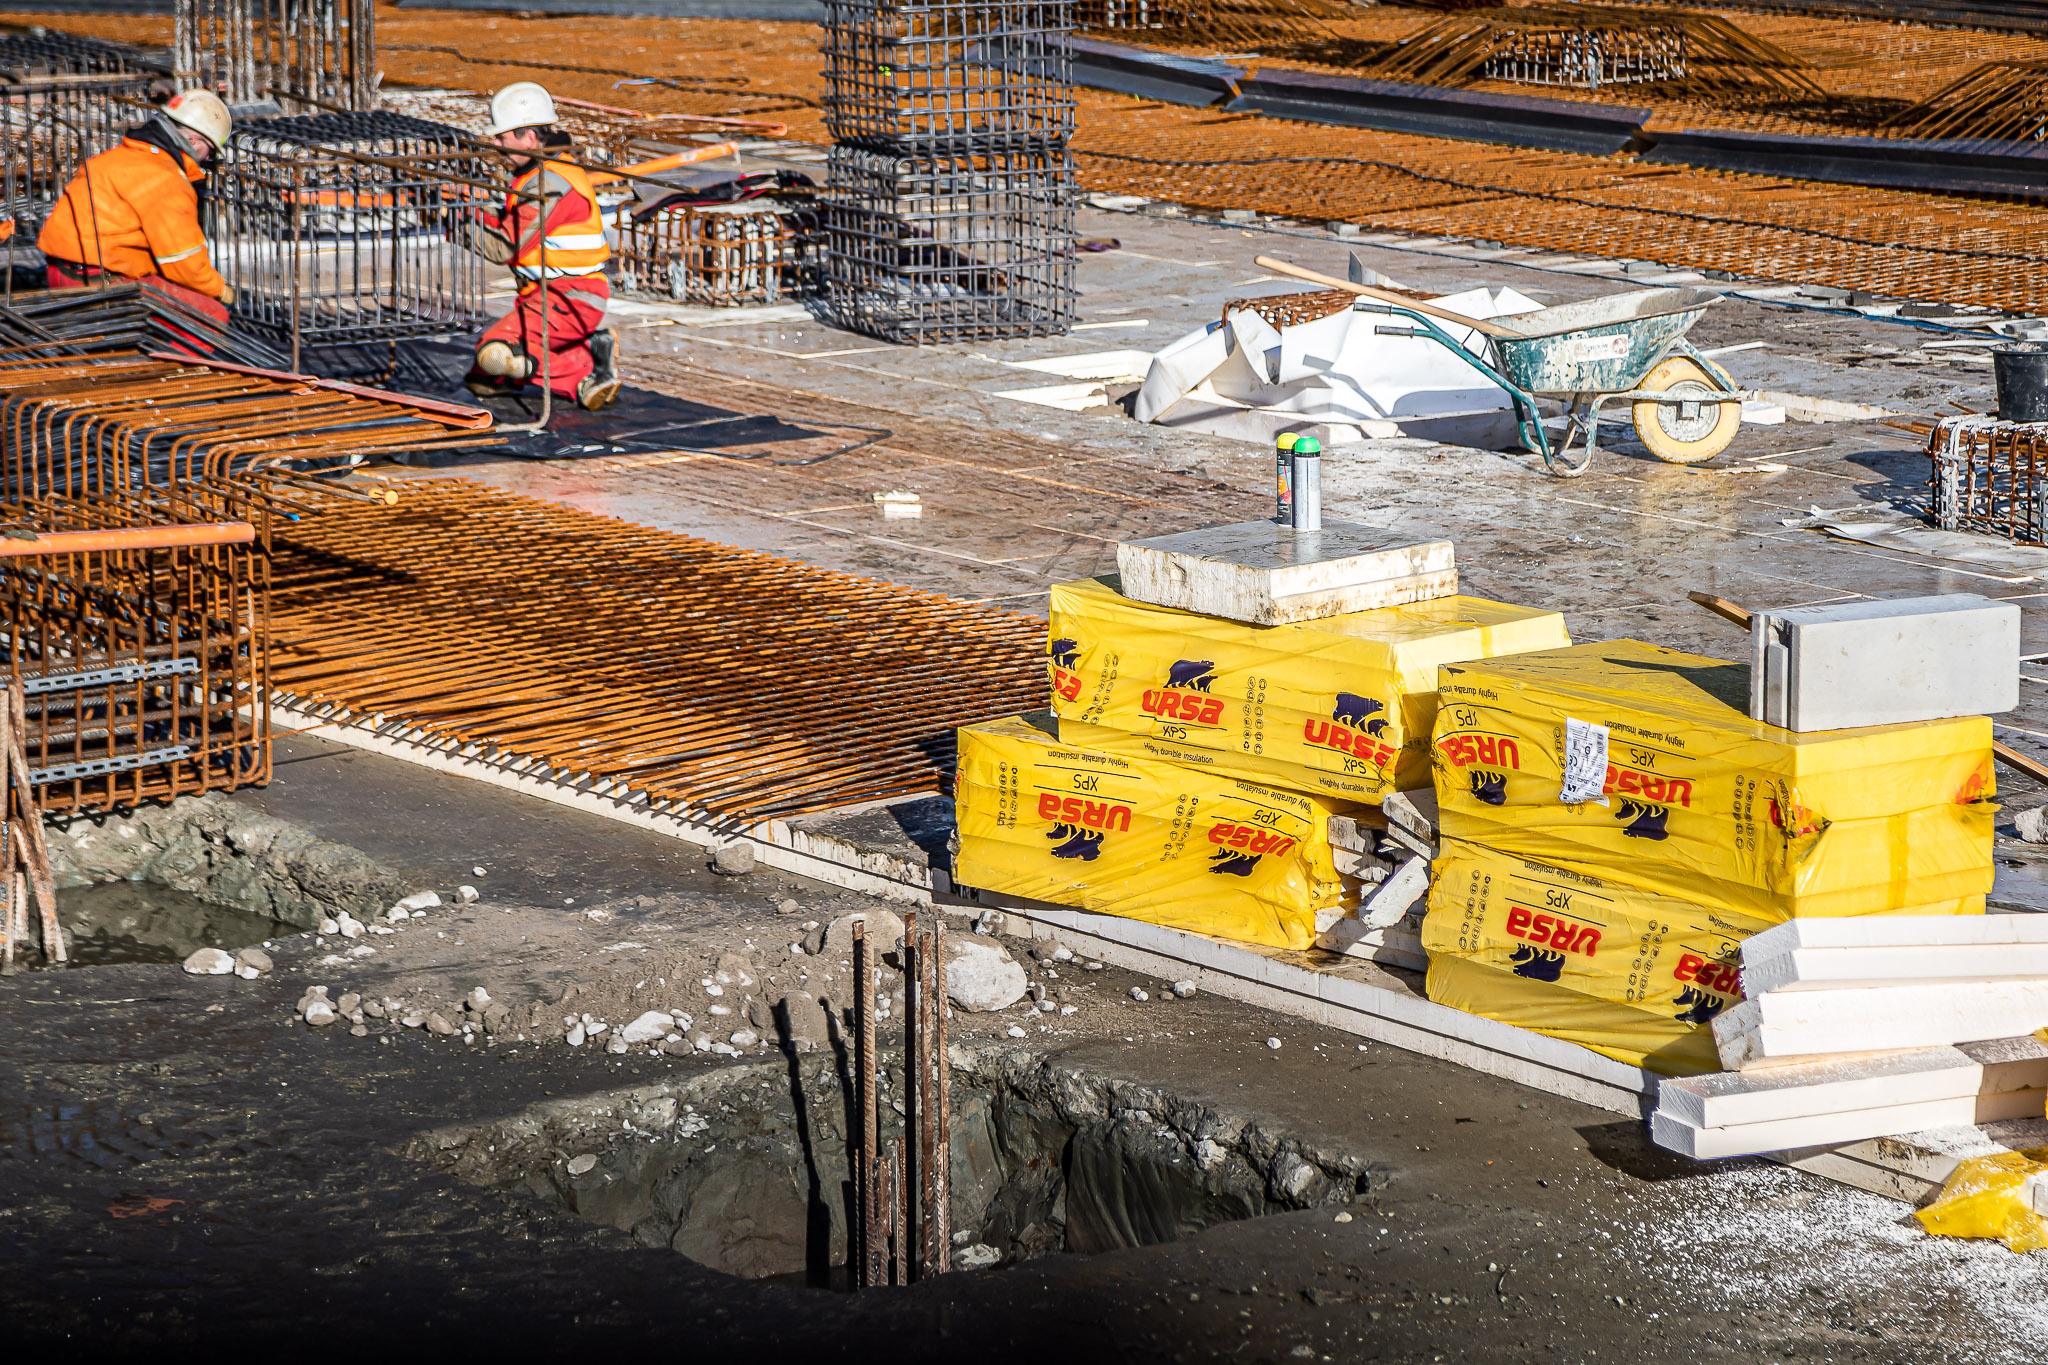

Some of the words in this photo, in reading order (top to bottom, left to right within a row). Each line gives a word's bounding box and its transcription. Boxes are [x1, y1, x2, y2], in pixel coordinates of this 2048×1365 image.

[1456, 709, 1480, 726] XPS
[1163, 726, 1187, 740] XPS
[1605, 720, 1637, 736] insulation
[1638, 729, 1664, 742] durable
[1665, 734, 1686, 749] Highly
[1047, 750, 1080, 760] insulation
[1081, 753, 1107, 764] durable
[1184, 752, 1214, 764] insulation
[1631, 749, 1656, 768] XPS
[1107, 757, 1129, 769] Highly
[1343, 757, 1367, 775] XPS
[1073, 774, 1099, 792] XPS
[1236, 781, 1269, 798] insulation
[1319, 777, 1339, 790] Highly
[1271, 791, 1297, 805] durable
[1252, 809, 1282, 825] XPS
[1524, 860, 1555, 874] insulation
[1556, 868, 1581, 882] durable
[1545, 889, 1572, 910] XPS
